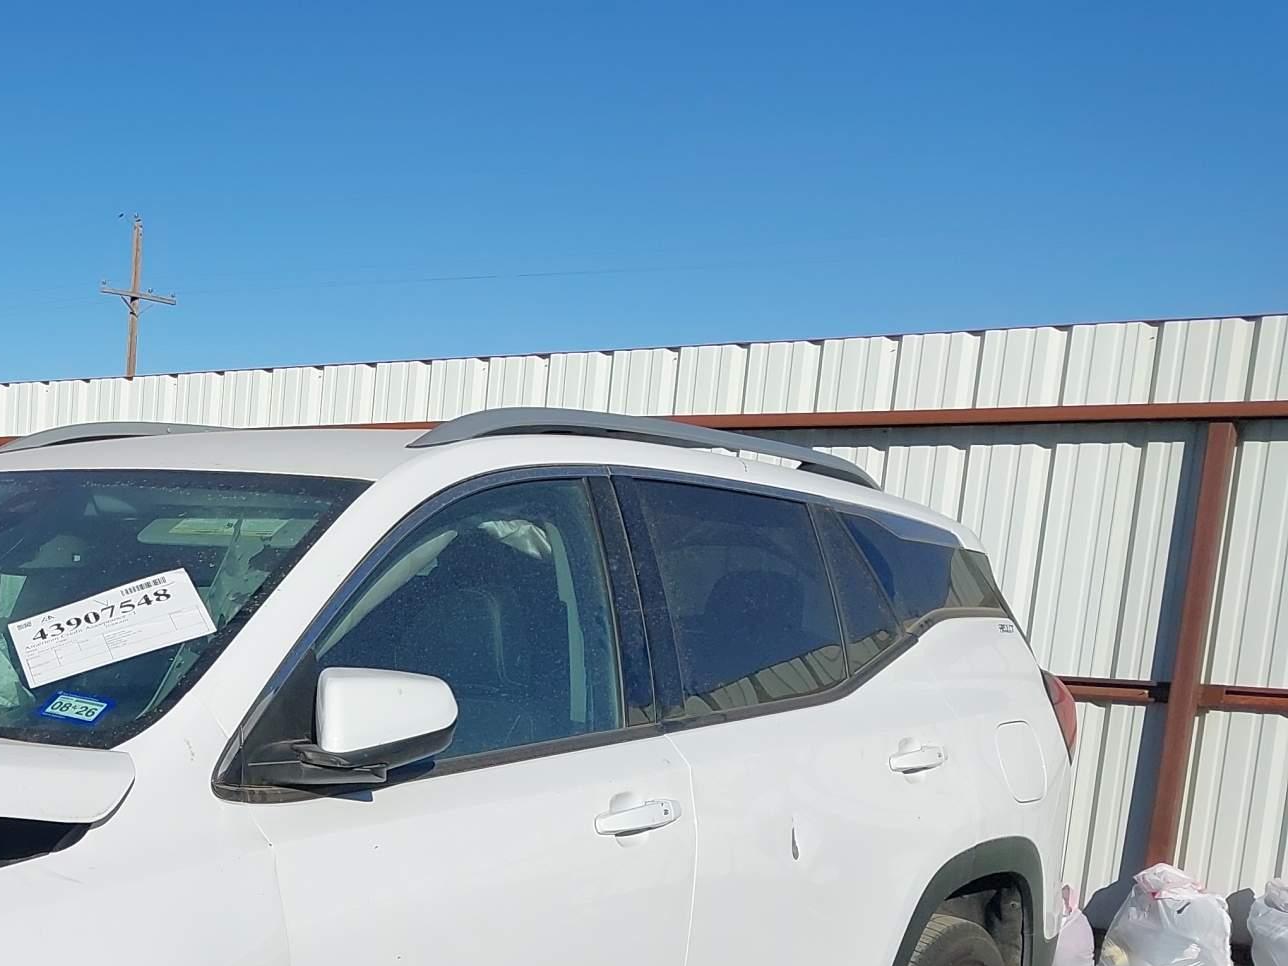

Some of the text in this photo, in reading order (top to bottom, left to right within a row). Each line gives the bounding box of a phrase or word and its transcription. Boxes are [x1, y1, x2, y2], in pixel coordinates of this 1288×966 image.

[32, 588, 171, 641] 43907548
[50, 701, 98, 717] 08 26
